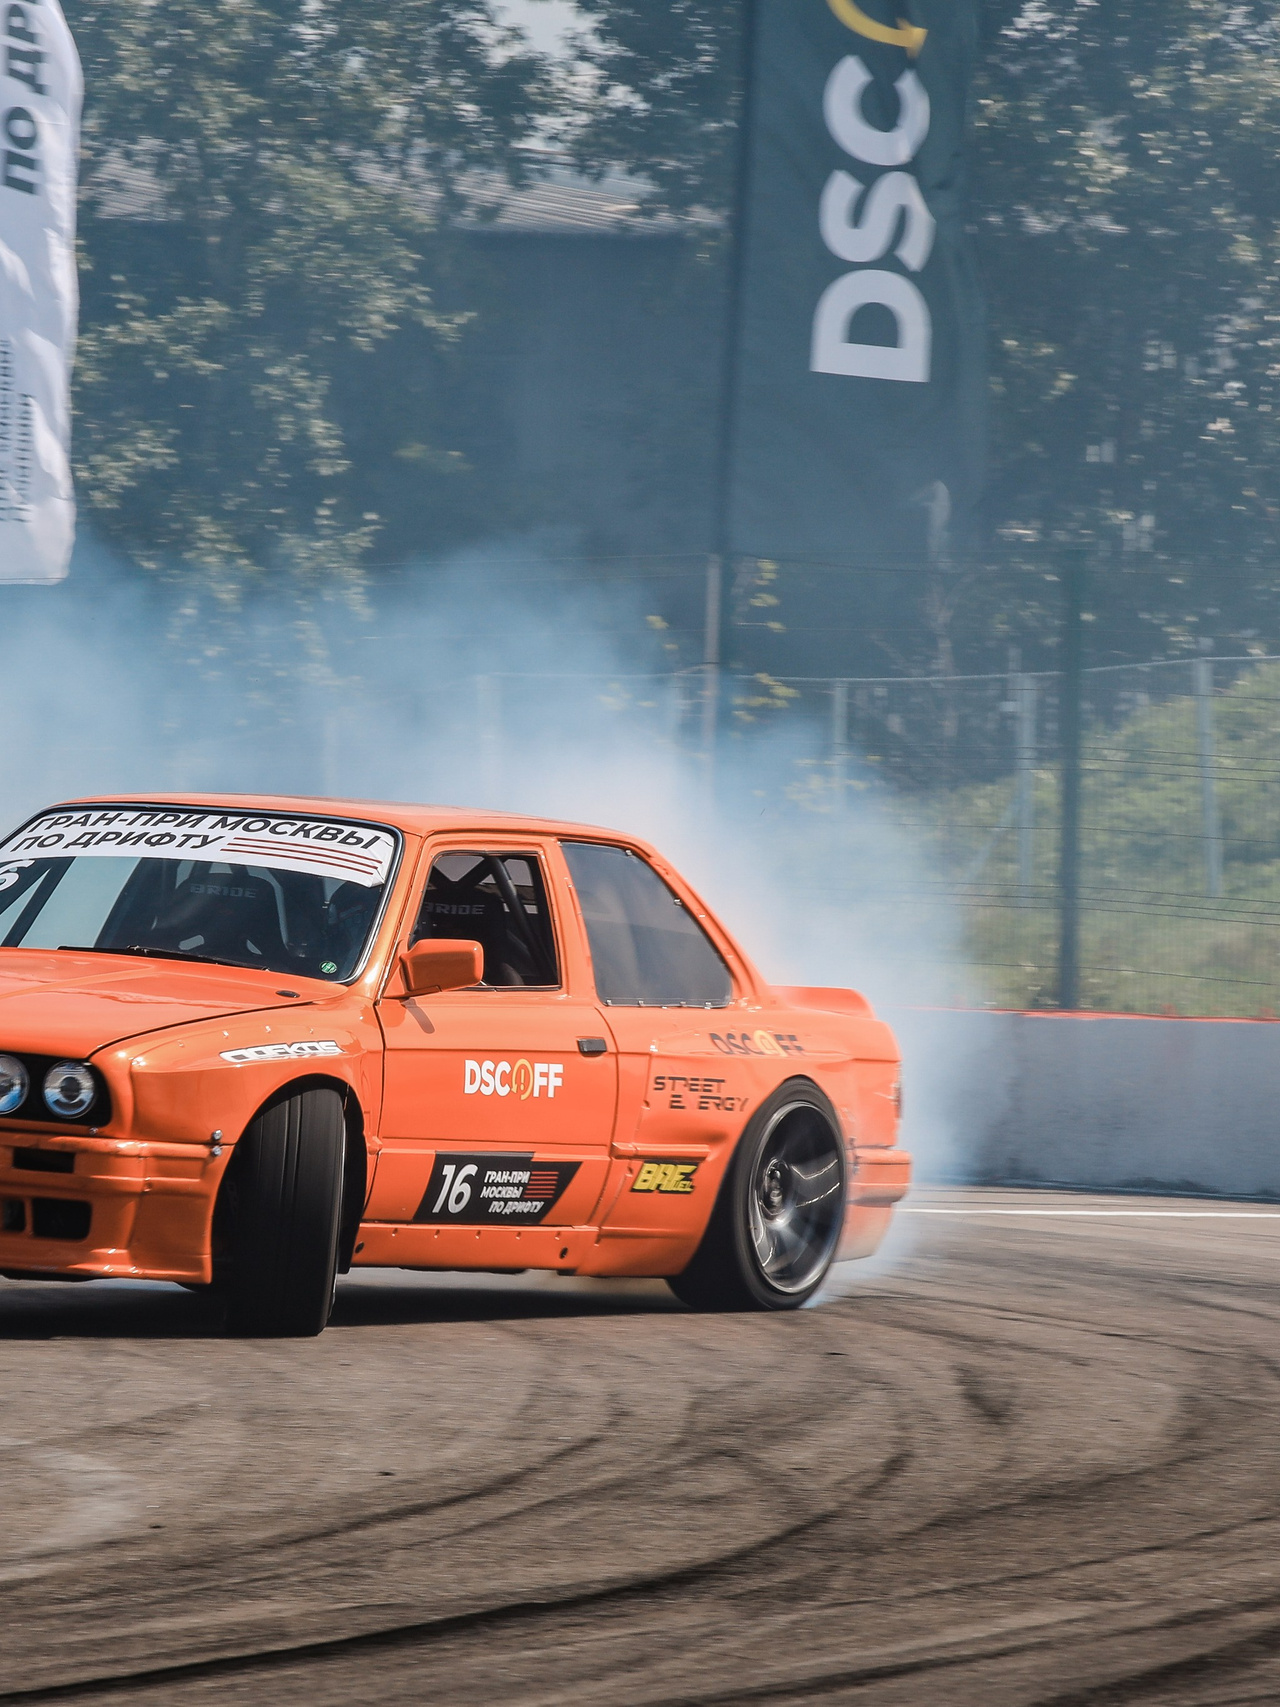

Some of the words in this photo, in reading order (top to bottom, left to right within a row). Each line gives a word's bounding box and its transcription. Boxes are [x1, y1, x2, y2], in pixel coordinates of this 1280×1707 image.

[2, 0, 50, 97] ДР
[0, 105, 41, 196] ПО
[809, 0, 936, 382] DSC
[10, 833, 66, 853] ПО
[61, 831, 226, 850] ДРИФТУ
[27, 812, 210, 833] ГРАН-ПРИ
[208, 816, 382, 850] МОСКВЫ
[190, 883, 257, 899] BRIDE
[669, 1094, 750, 1112] EERGY
[484, 1170, 531, 1184] ГРАН-ПРИ
[432, 1163, 479, 1214] 16
[480, 1186, 523, 1199] МОСКВЫ
[488, 1201, 504, 1213] ПО
[502, 1201, 545, 1215] ДРИФТУ
